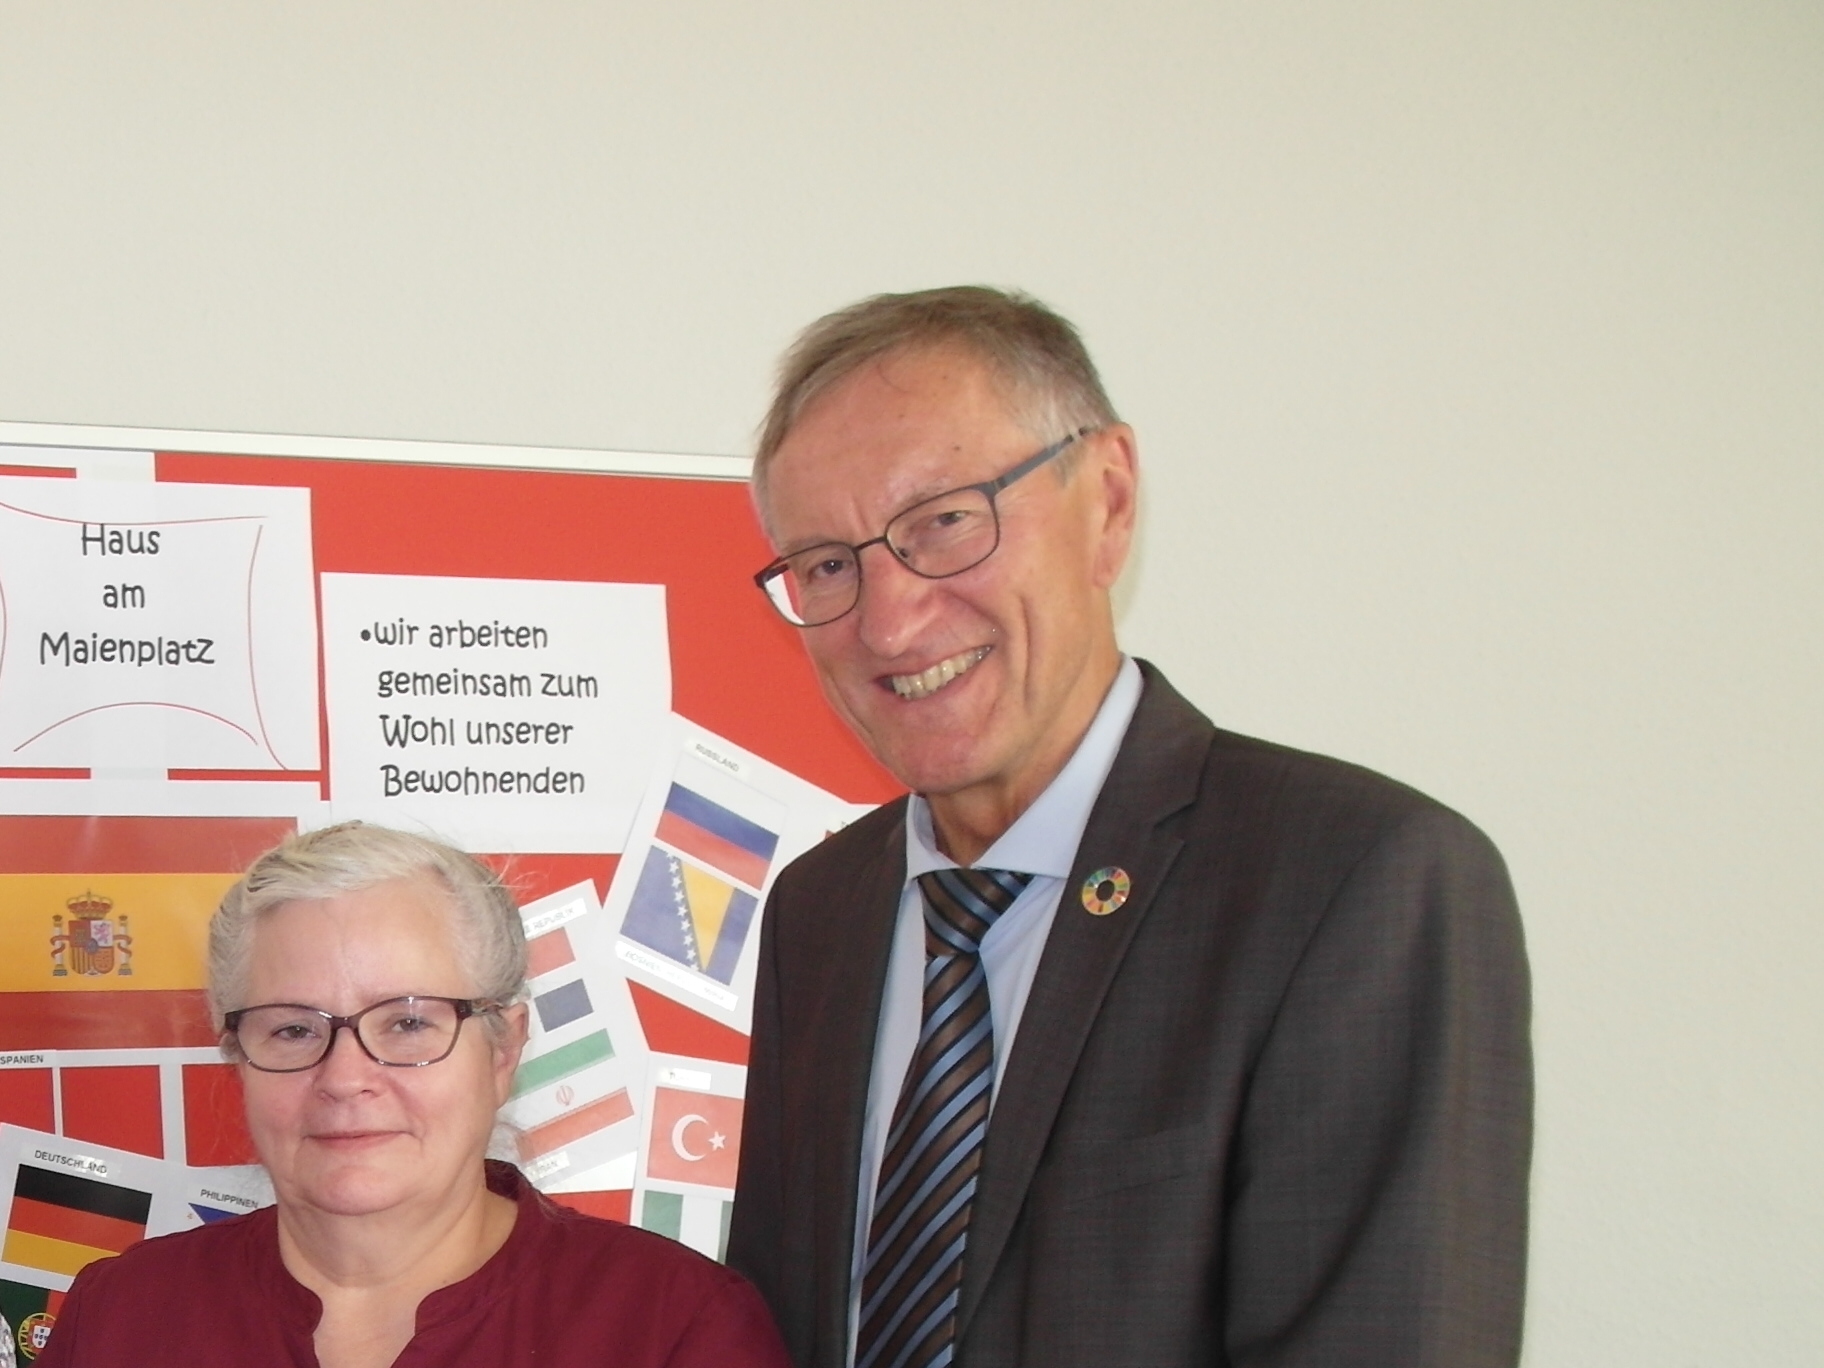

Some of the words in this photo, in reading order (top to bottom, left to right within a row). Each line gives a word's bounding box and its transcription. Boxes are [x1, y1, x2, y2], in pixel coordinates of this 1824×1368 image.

[79, 522, 161, 557] Haus
[101, 581, 147, 610] am
[373, 619, 420, 647] wir
[428, 619, 549, 649] arbeiten
[38, 632, 216, 668] Maienplatz
[376, 668, 532, 699] gemeinsam
[540, 671, 599, 699] zum
[379, 714, 456, 748] Wohl
[465, 717, 574, 747] unserer
[695, 743, 740, 773] RUSSLAND
[381, 764, 585, 798] Bewohnenden
[0, 1054, 44, 1066] SPANIEN
[34, 1149, 107, 1175] DEUTSCHLAND
[199, 1188, 259, 1209] PHILIPPINEN
